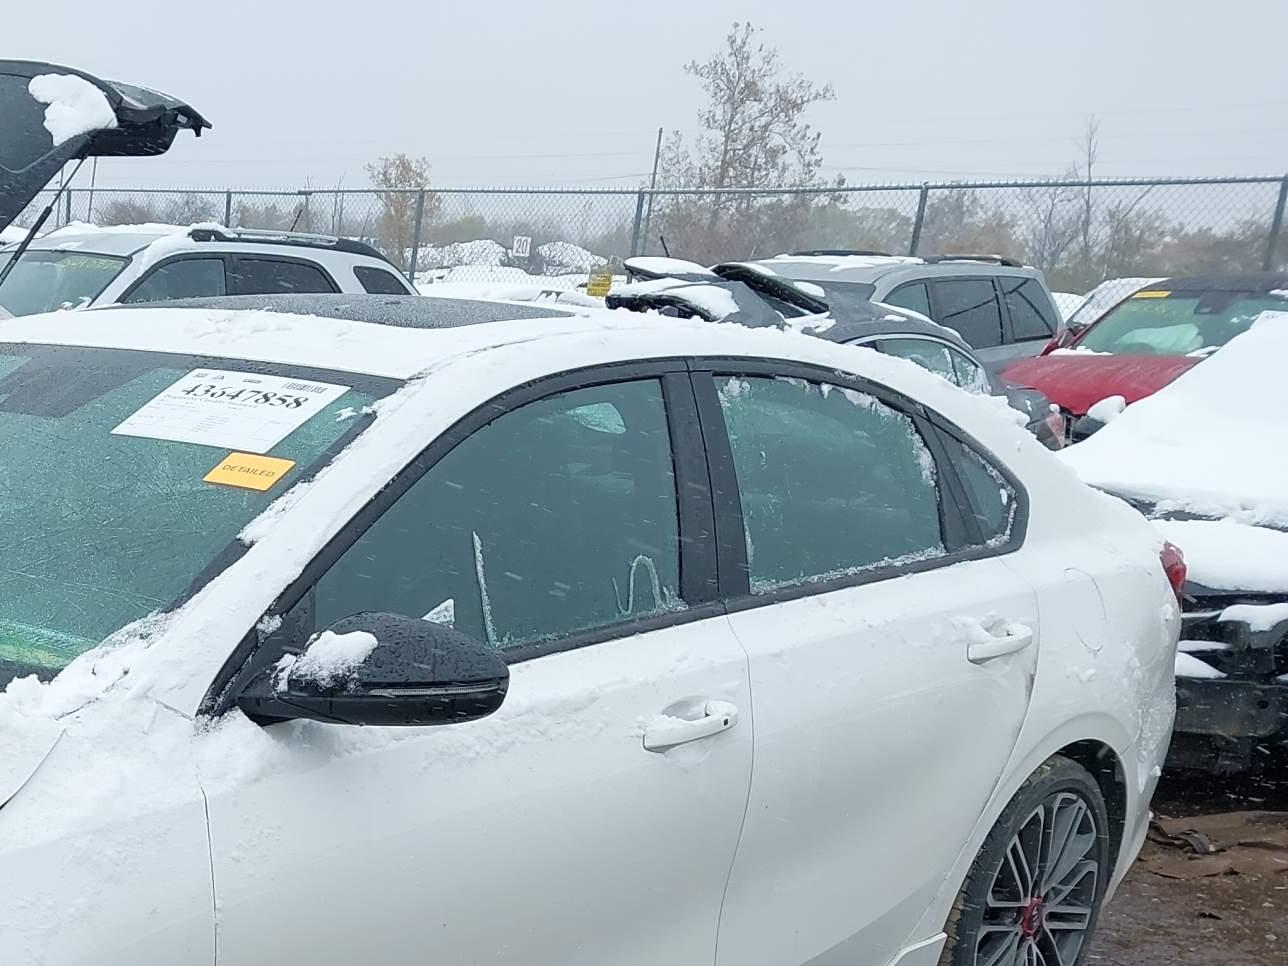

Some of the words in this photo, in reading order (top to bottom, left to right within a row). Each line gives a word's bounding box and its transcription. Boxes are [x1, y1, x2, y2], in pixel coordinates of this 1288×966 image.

[516, 239, 528, 254] 20
[181, 383, 309, 409] 43647858
[222, 464, 275, 477] DETAILED
